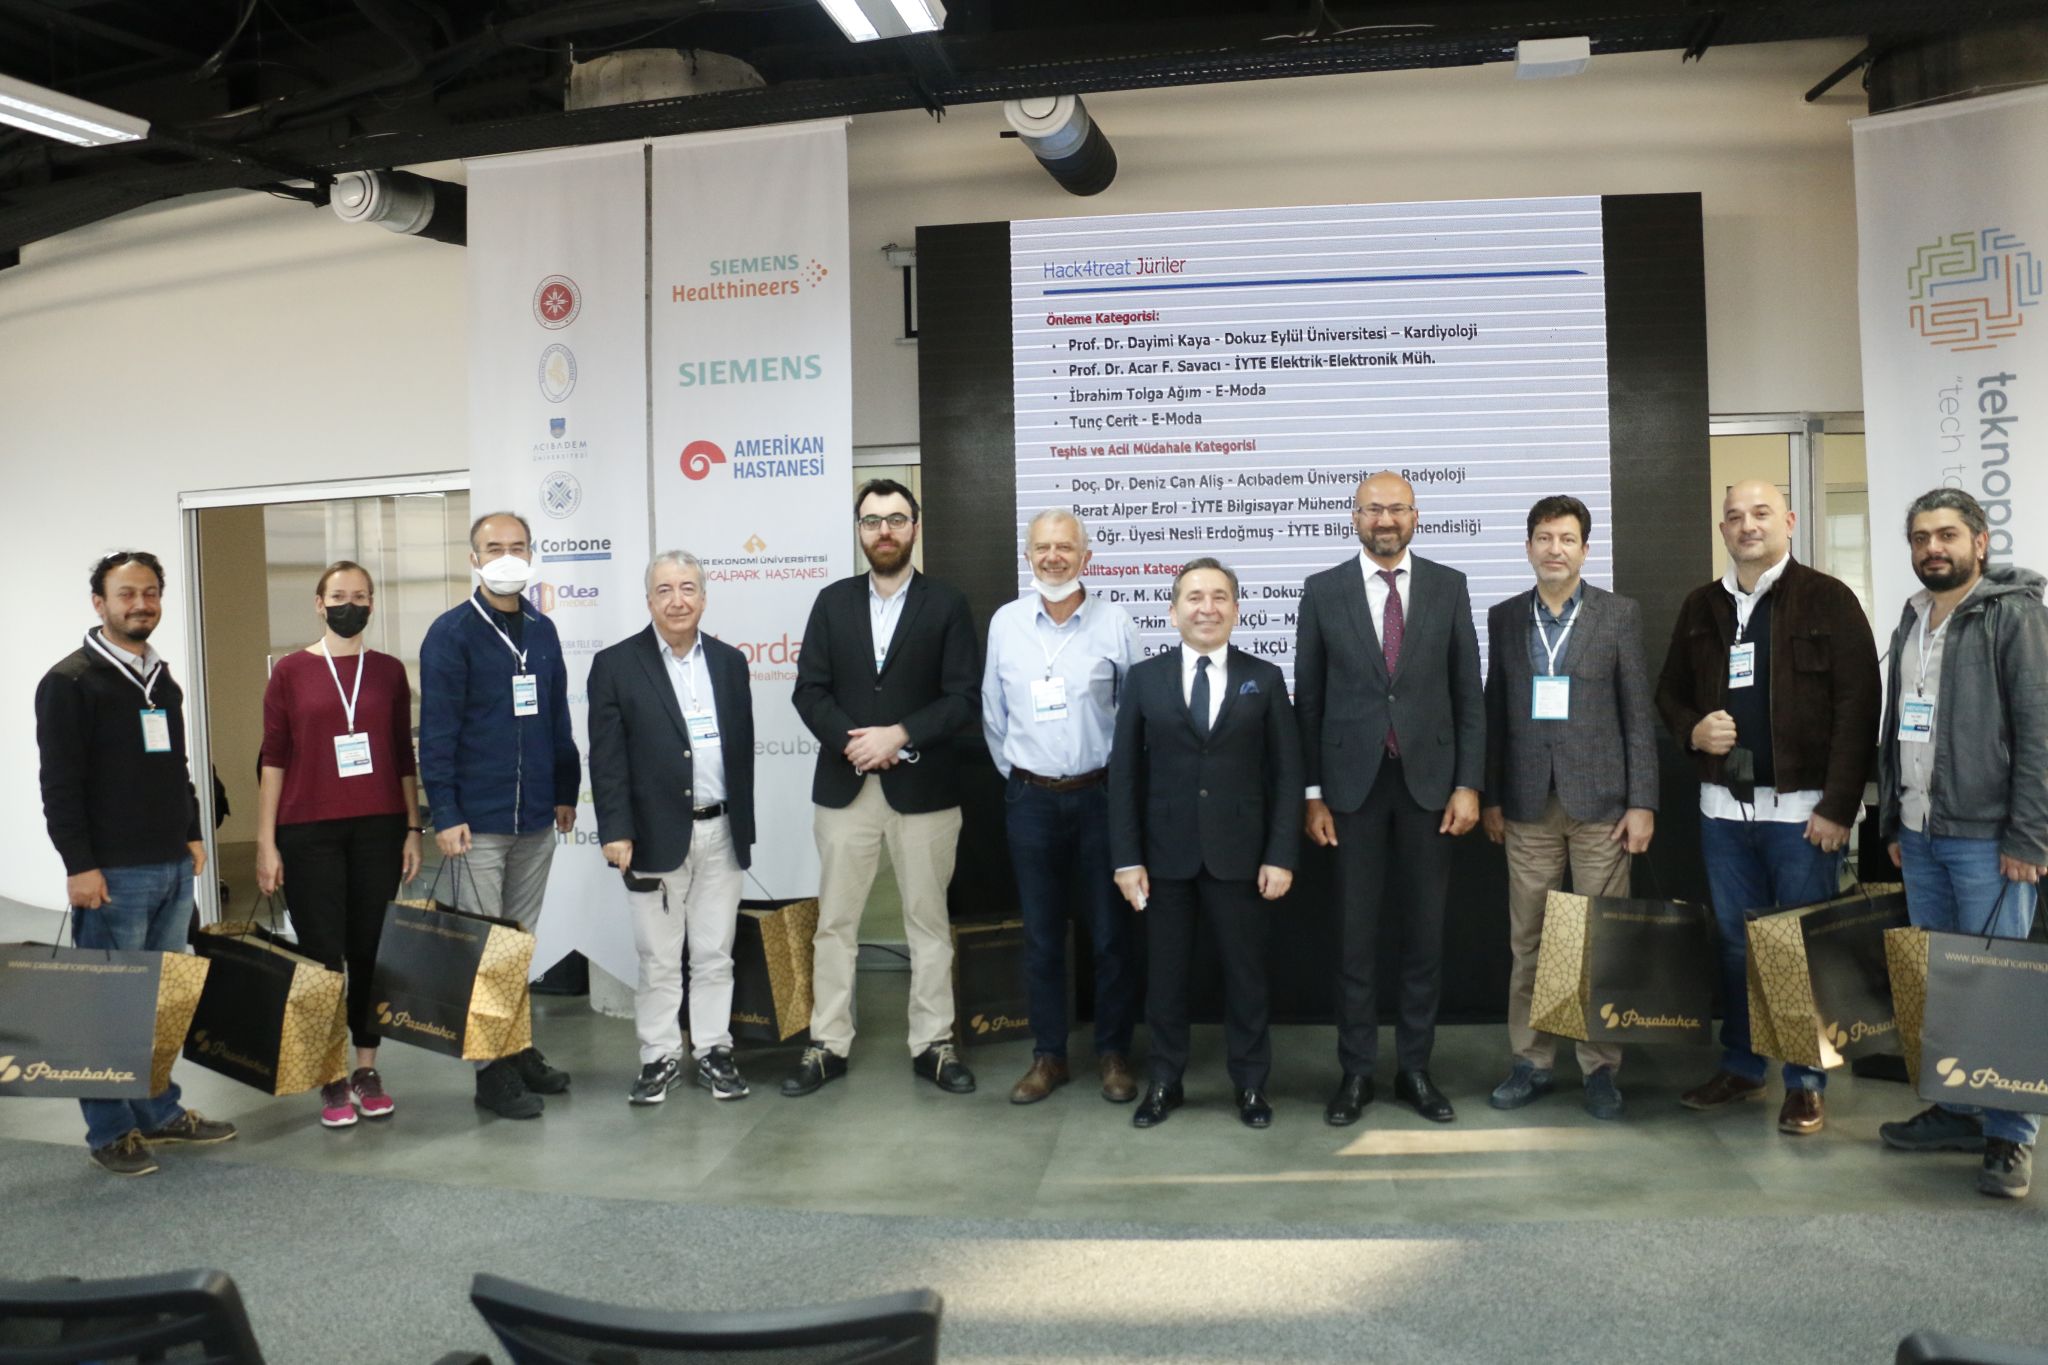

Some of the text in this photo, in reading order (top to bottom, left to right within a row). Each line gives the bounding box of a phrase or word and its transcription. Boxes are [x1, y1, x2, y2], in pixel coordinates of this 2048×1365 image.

[709, 254, 799, 276] SIEMENS
[1043, 257, 1187, 279] Hack4treat Jüriler
[672, 278, 800, 303] Healthineers
[1046, 310, 1160, 327] Önleme Kategorisi:
[1068, 338, 1100, 352] Prof.
[1105, 337, 1124, 350] Dr.
[1127, 334, 1174, 351] Dayimi
[1177, 333, 1211, 350] Kaya
[1224, 331, 1267, 346] Dokuz
[1271, 328, 1304, 346] Eylül
[1307, 326, 1388, 342] Üniversitesi
[1403, 323, 1478, 341] Kardiyoloji
[679, 354, 823, 387] SIEMENS
[1068, 364, 1100, 377] Prof.
[1105, 363, 1124, 376] Dr.
[1128, 361, 1159, 375] Acar
[1162, 360, 1174, 373] F.
[1177, 358, 1221, 373] Savacı
[1234, 355, 1267, 371] İYTE
[1270, 352, 1399, 370] Elektrik-Elektronik
[1402, 351, 1437, 366] Müh.
[1069, 386, 1123, 403] İbrahim
[1126, 386, 1164, 403] Tolga
[1166, 385, 1202, 402] Ağım
[1215, 383, 1267, 398] E-Moda
[1069, 415, 1103, 431] Tunç
[1106, 412, 1139, 428] Cerit
[1151, 411, 1203, 426] E-Moda
[733, 434, 825, 458] AMERİKAN
[1050, 439, 1257, 460] Teşhis ve Acil Müdahale Kategorisi
[733, 454, 825, 480] HASTANESİ
[1977, 371, 2019, 568] teknopa
[1072, 479, 1101, 495] Doç.
[1104, 477, 1125, 491] Dr.
[1128, 475, 1166, 491] Deniz
[1169, 474, 1196, 489] Can
[1199, 473, 1224, 491] Aliş
[1236, 470, 1304, 487] Acıbadem
[1307, 468, 1380, 486] Üniversit
[1401, 467, 1467, 485] Radyoloji
[1072, 503, 1108, 517] Berat
[1112, 502, 1148, 519] Alper
[1151, 500, 1178, 516] Erol
[1191, 497, 1223, 514] İYTE
[1227, 496, 1294, 515] Bilgisayar
[1297, 495, 1356, 511] Mühendi
[1096, 526, 1126, 546] Öğr.
[1129, 525, 1165, 545] Üyesi
[1169, 525, 1202, 541] Nesli
[1206, 522, 1275, 542] Erdoğmuş
[1287, 520, 1320, 538] İYTE
[541, 538, 612, 553] Corbone
[711, 555, 759, 566] EKONOMİ
[1110, 589, 1130, 603] Dr.
[1133, 589, 1150, 602] M.
[1262, 585, 1305, 599] Dokuz
[1240, 609, 1268, 630] KÇÜ
[1253, 637, 1288, 657] İKÇÜ
[1621, 1008, 1700, 1029] Paşabahçe
[22, 1061, 137, 1083] Paşabahçe
[1969, 1066, 2048, 1095] Paşab
